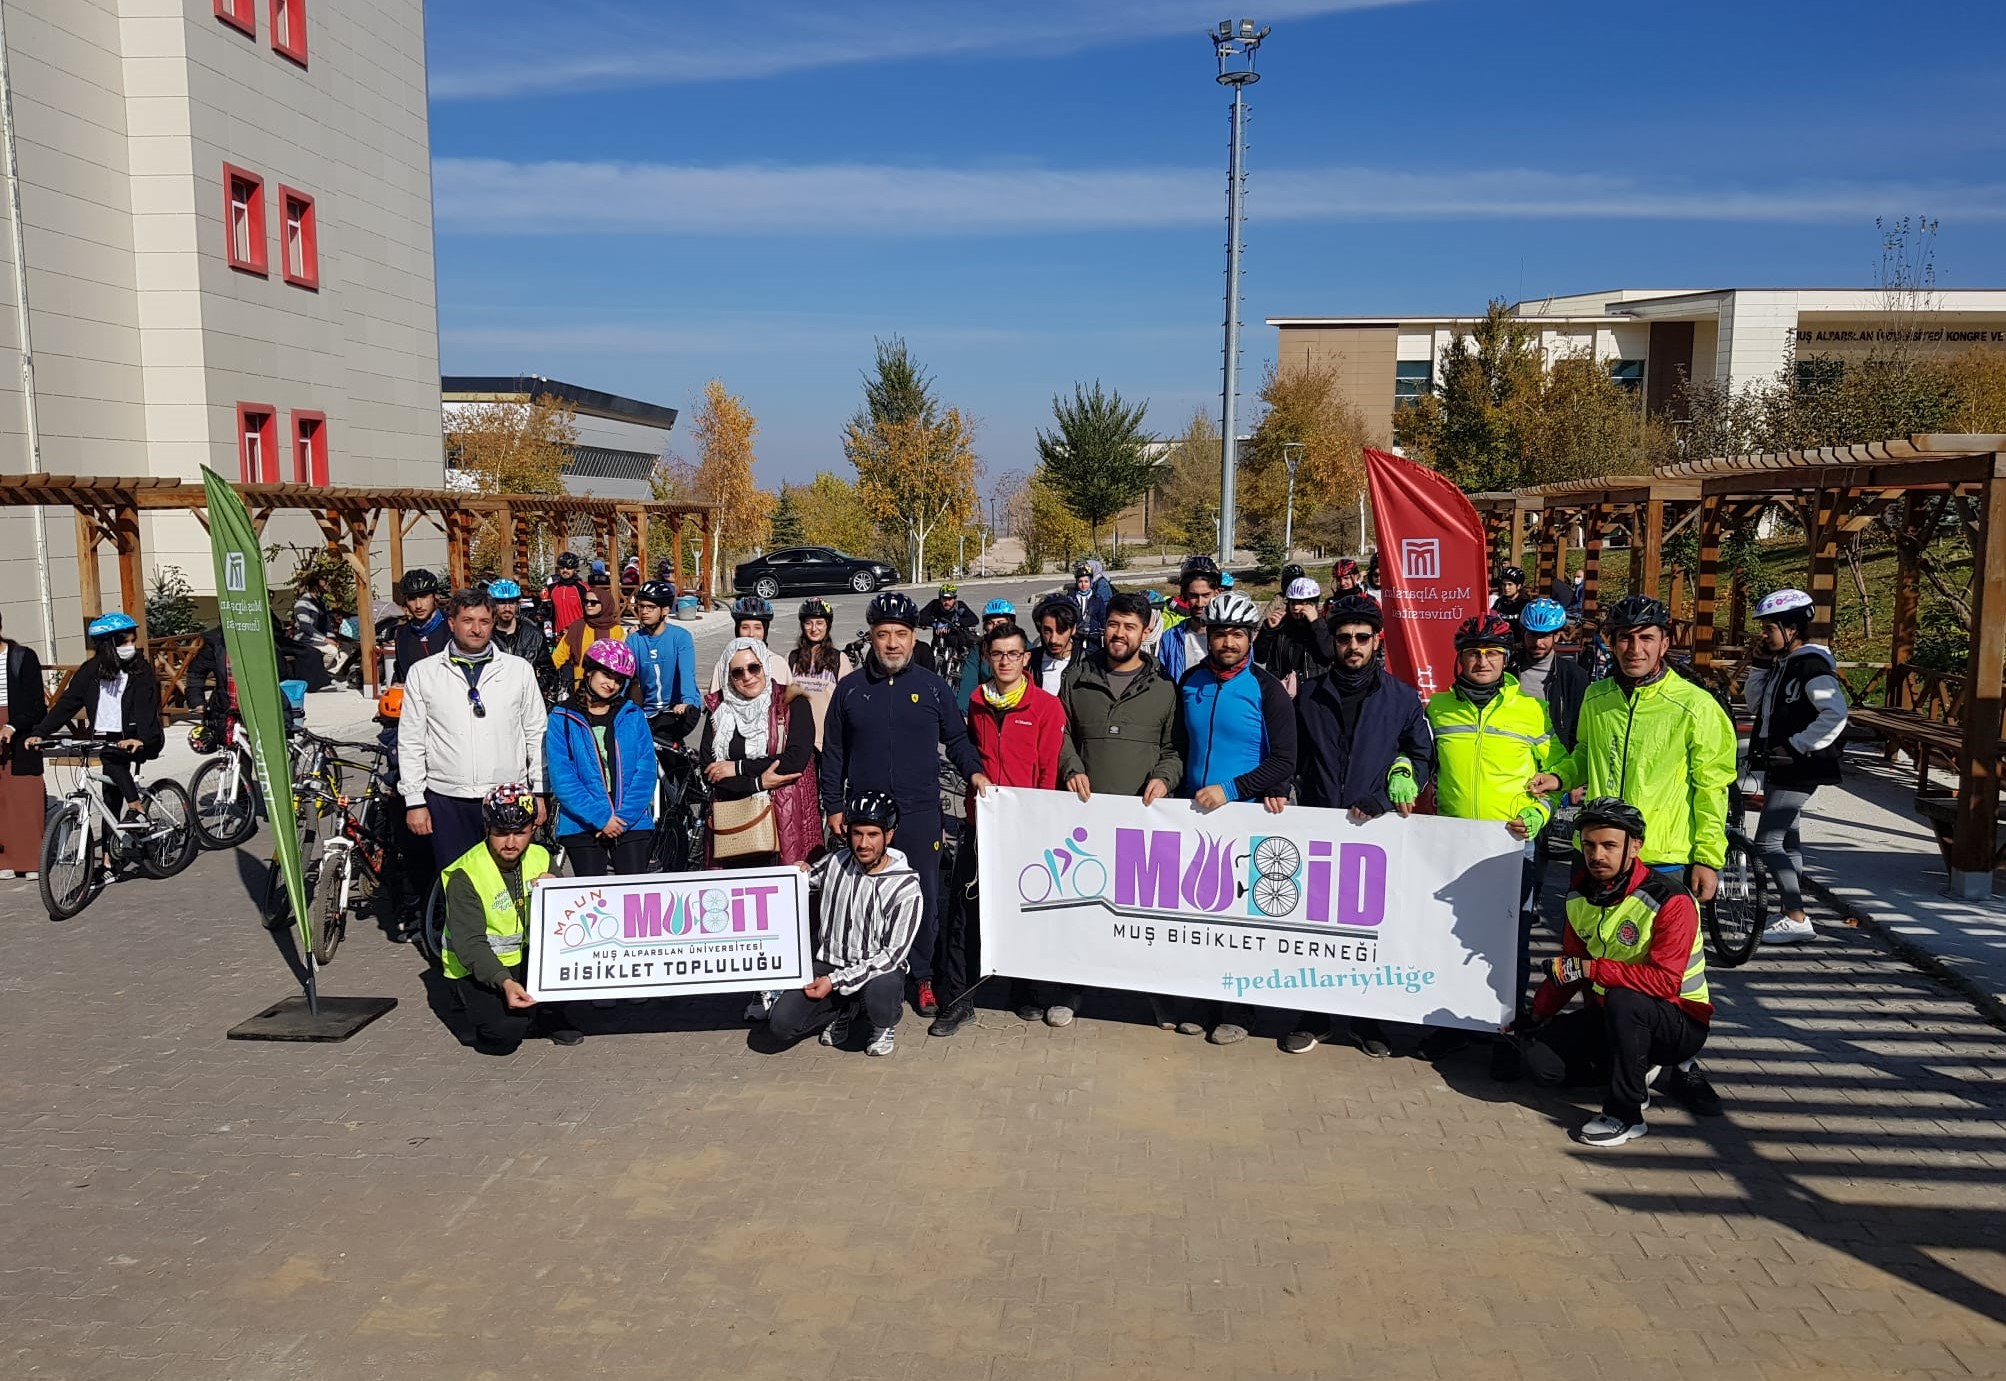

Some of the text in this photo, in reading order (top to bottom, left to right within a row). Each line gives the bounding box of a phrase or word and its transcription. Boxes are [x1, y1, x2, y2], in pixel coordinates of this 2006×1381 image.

[1797, 330, 1813, 344] UŞ
[1946, 331, 1988, 342] KONGRE
[1990, 331, 2004, 342] VE
[592, 940, 763, 961] MUŞ ALPARSLAN ÜNİVERSİTESİ
[1113, 924, 1378, 964] MUŞ BİSİKLET DERNEĞİ
[560, 953, 783, 982] BİSİKLET TOPLULUĞU
[1221, 964, 1436, 998] #pedallariyiliğe
